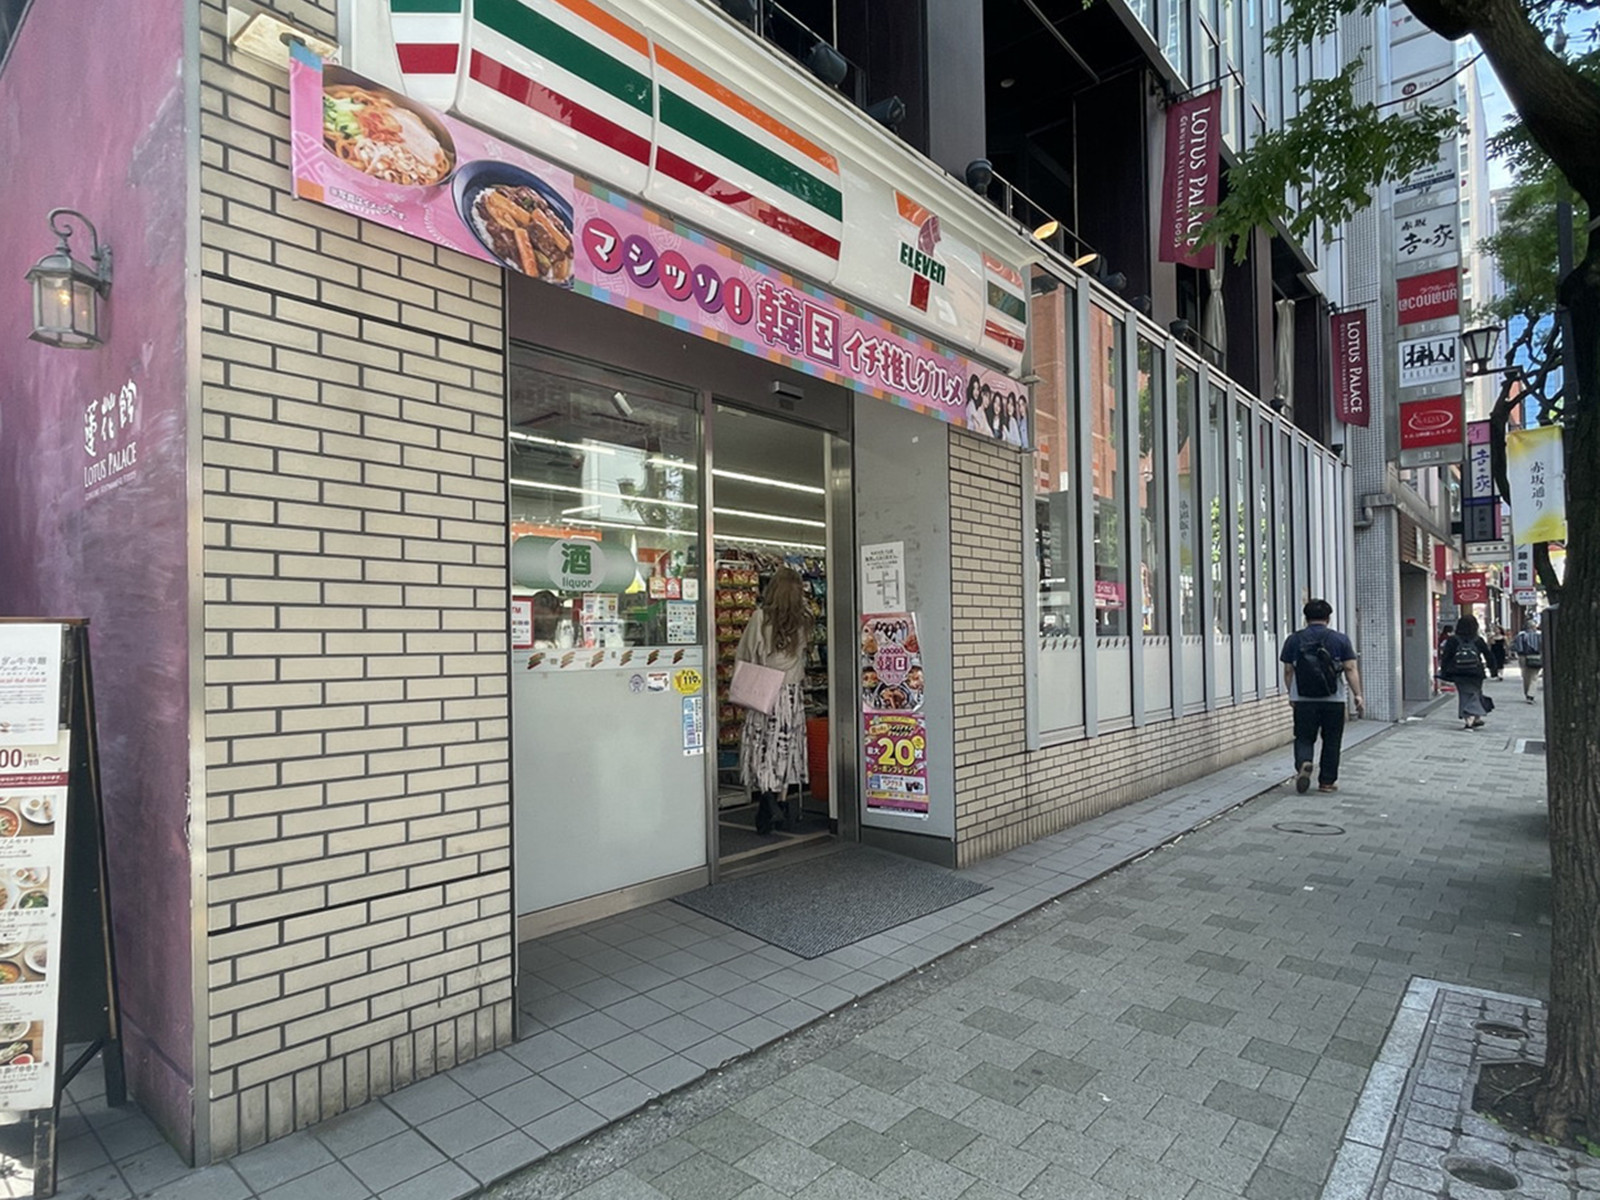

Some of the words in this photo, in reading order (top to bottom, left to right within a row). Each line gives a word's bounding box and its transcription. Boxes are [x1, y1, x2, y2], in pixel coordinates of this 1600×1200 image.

[1189, 107, 1211, 170] LOTUS
[1347, 321, 1361, 363] LOTUS
[843, 331, 963, 405] イチ推しグルメ
[1350, 367, 1363, 413] PALACE
[84, 459, 107, 488] LOTUS
[1530, 461, 1546, 510] 赤坂通り
[561, 543, 591, 575] 酒
[562, 577, 593, 589] liquor
[877, 737, 915, 767] 20
